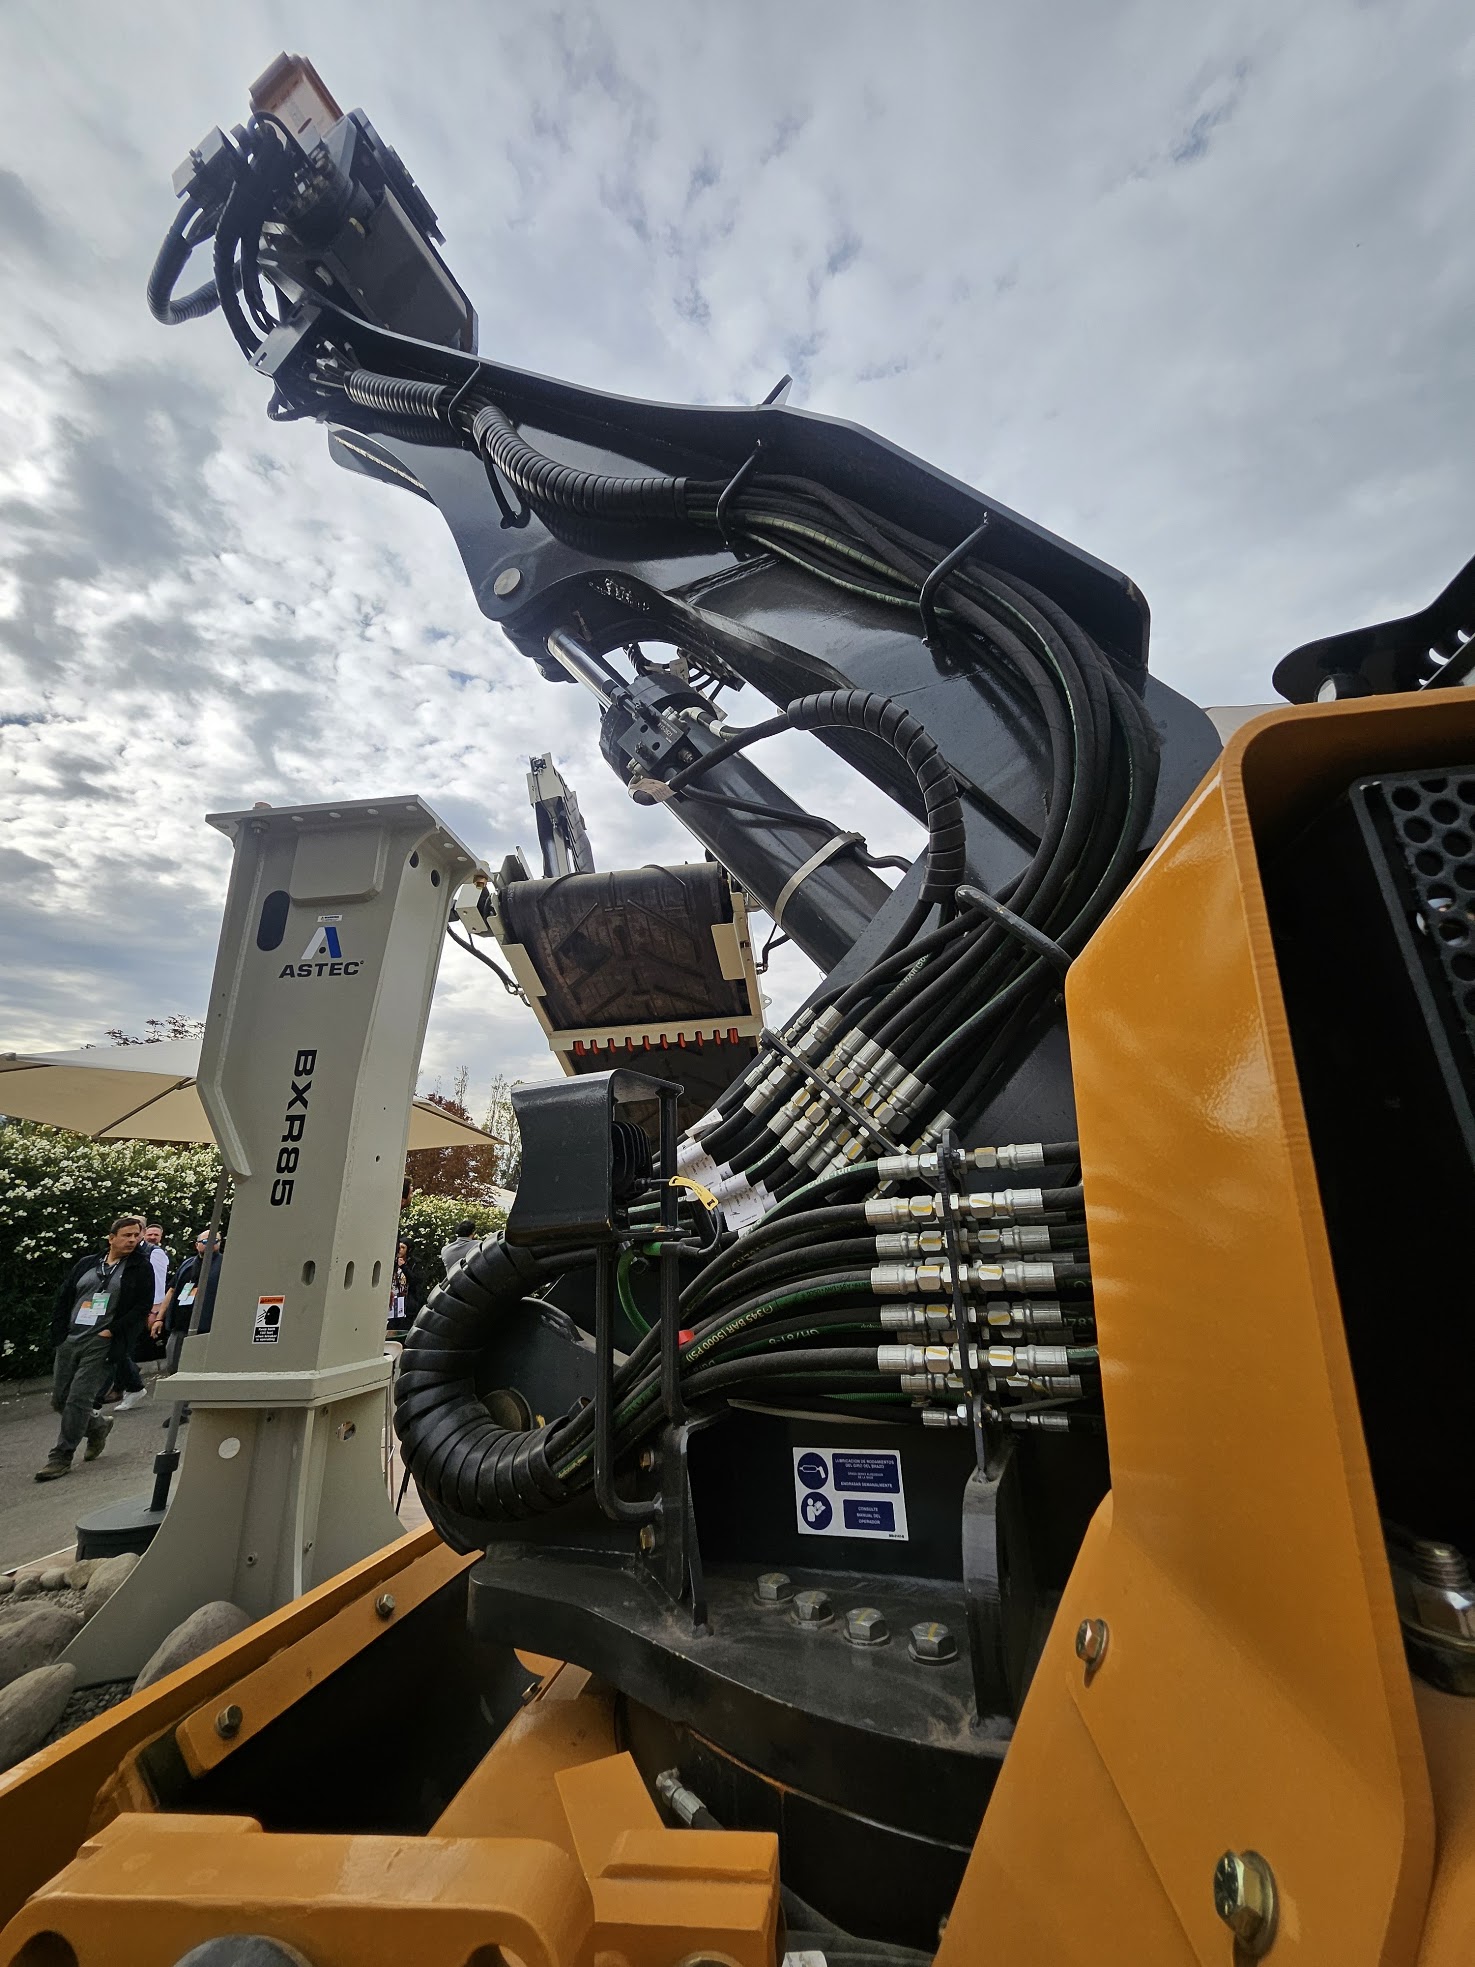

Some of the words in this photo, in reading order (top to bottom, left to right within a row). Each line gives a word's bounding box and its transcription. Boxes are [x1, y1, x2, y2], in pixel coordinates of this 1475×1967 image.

[278, 961, 360, 978] ASTEC
[270, 1049, 317, 1206] BXR85
[725, 1319, 747, 1334] BAR
[703, 1330, 728, 1350] (5000
[686, 1349, 704, 1362] PSI)
